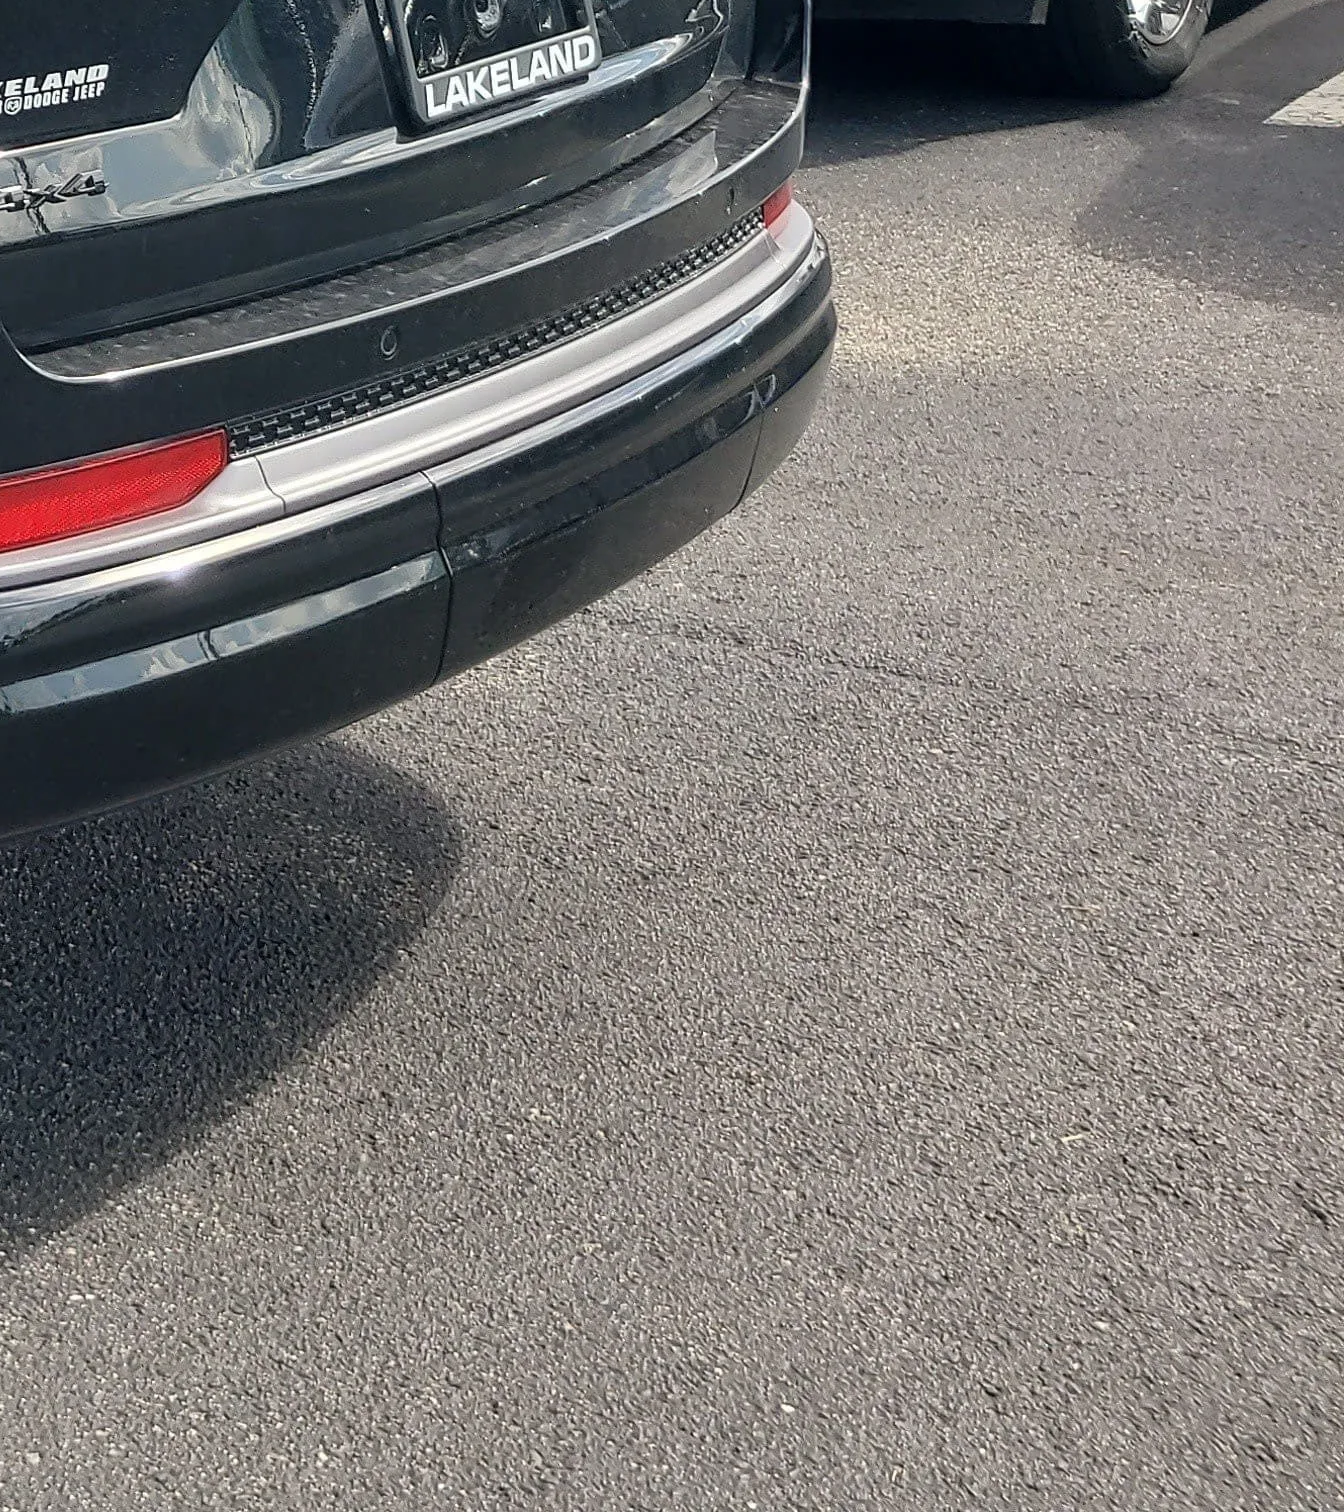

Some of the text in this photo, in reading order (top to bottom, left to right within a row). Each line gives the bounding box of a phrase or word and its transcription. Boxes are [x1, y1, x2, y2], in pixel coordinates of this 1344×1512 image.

[23, 89, 69, 110] DODGE
[73, 81, 106, 101] JEEP
[425, 34, 597, 118] LAKELAND
